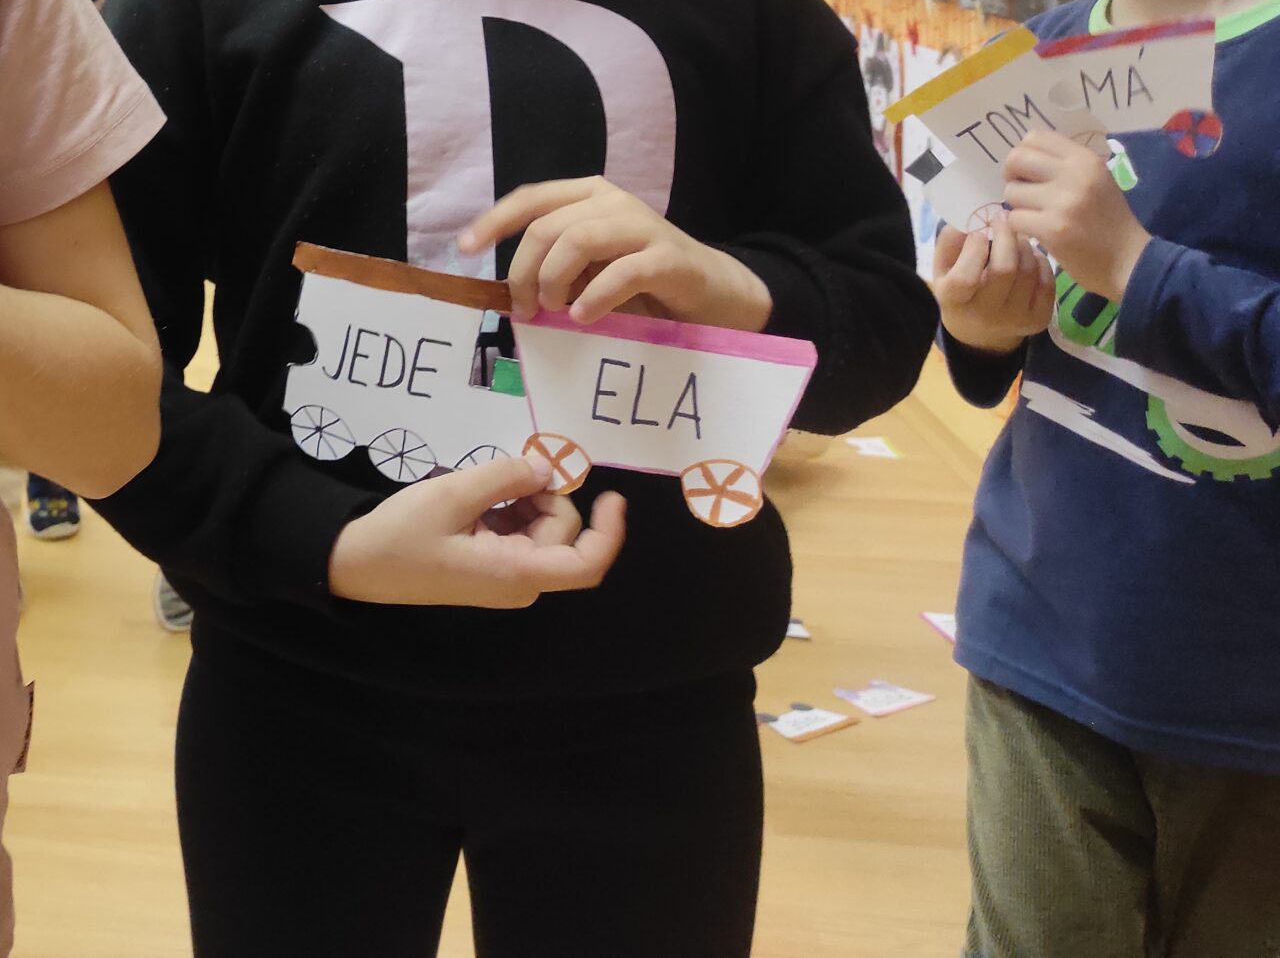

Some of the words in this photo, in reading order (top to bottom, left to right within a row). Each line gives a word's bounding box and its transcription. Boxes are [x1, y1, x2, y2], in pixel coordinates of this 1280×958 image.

[1080, 46, 1153, 109] MÁ
[955, 93, 1057, 163] TOM
[321, 323, 454, 399] JEDE
[592, 358, 702, 440] ELA
